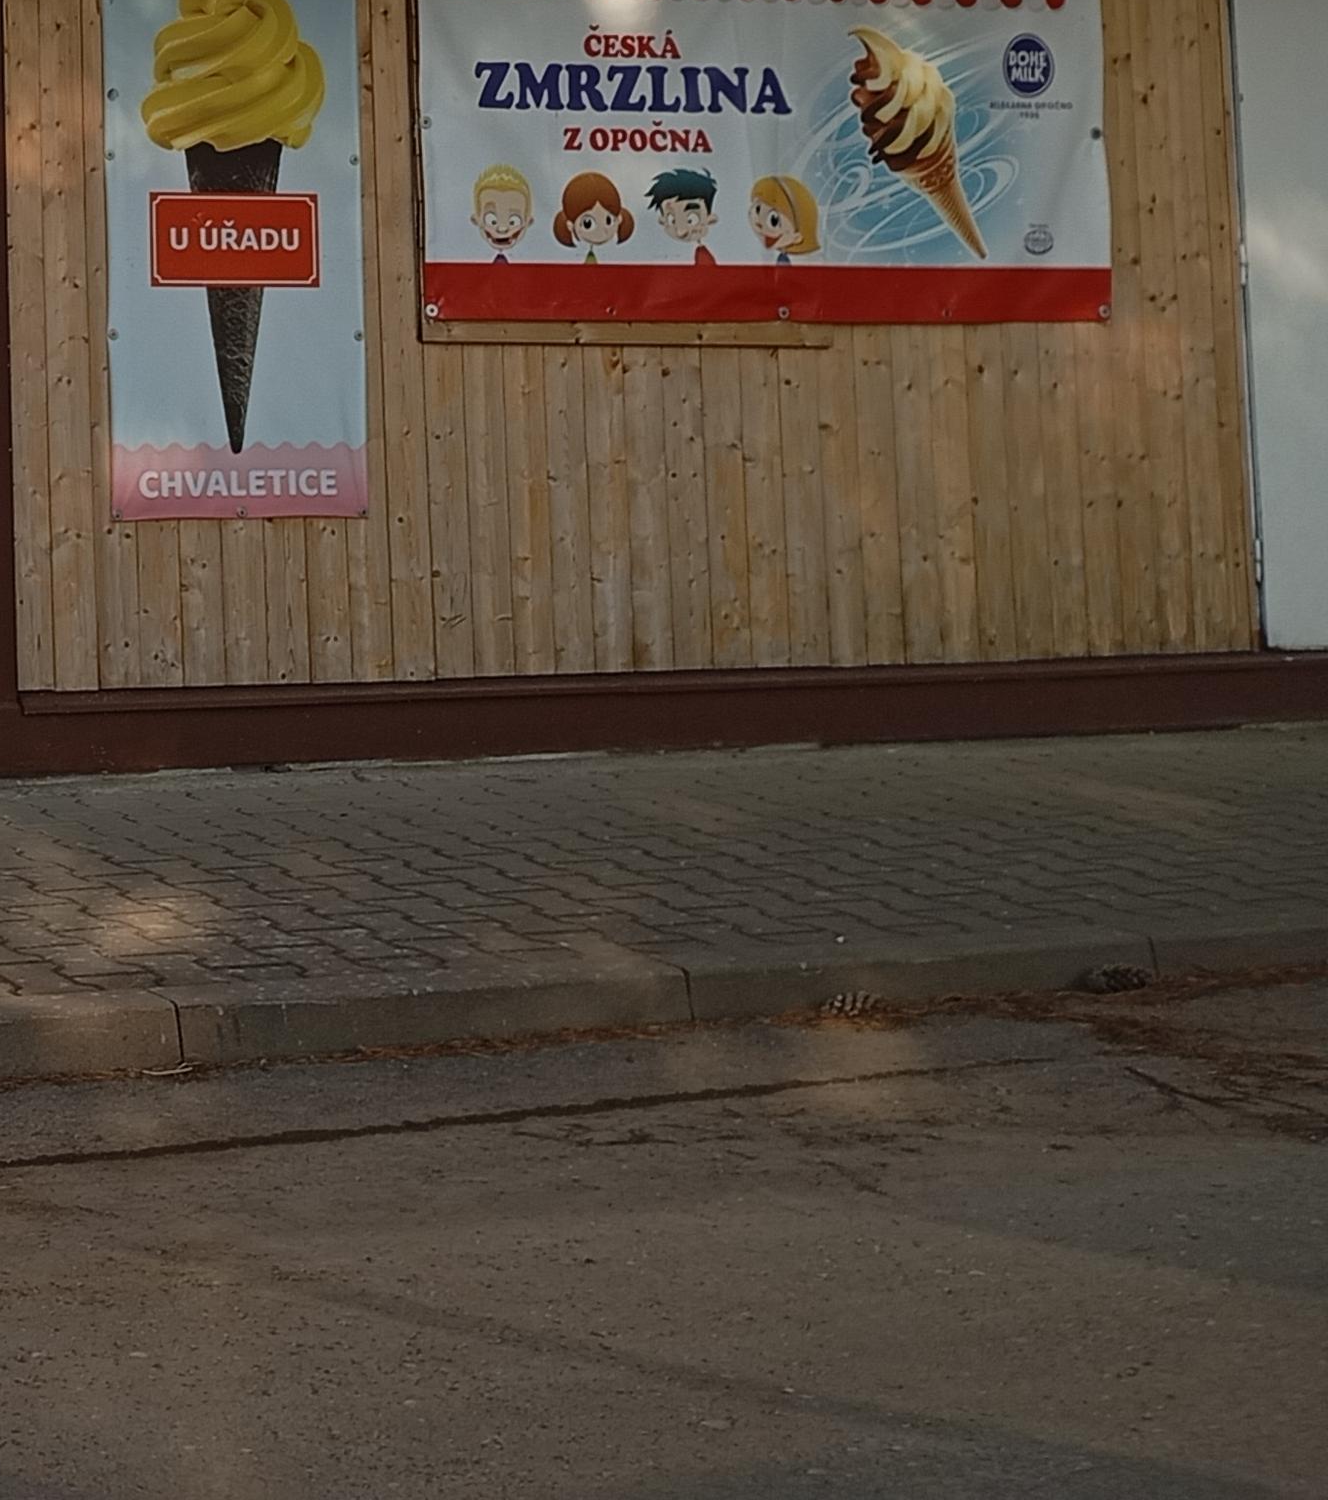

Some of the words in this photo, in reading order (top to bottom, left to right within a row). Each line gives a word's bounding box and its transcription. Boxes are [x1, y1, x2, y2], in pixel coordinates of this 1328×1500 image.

[584, 25, 681, 59] ČESKÁ
[1009, 50, 1047, 67] BOHE
[1011, 66, 1045, 83] MILK
[475, 61, 792, 115] ZMRZLINA
[563, 128, 582, 151] Z
[589, 120, 713, 153] OPOČNA
[169, 227, 188, 250] U
[199, 219, 300, 251] ÚŘADU
[138, 468, 338, 499] CHVALETICE
